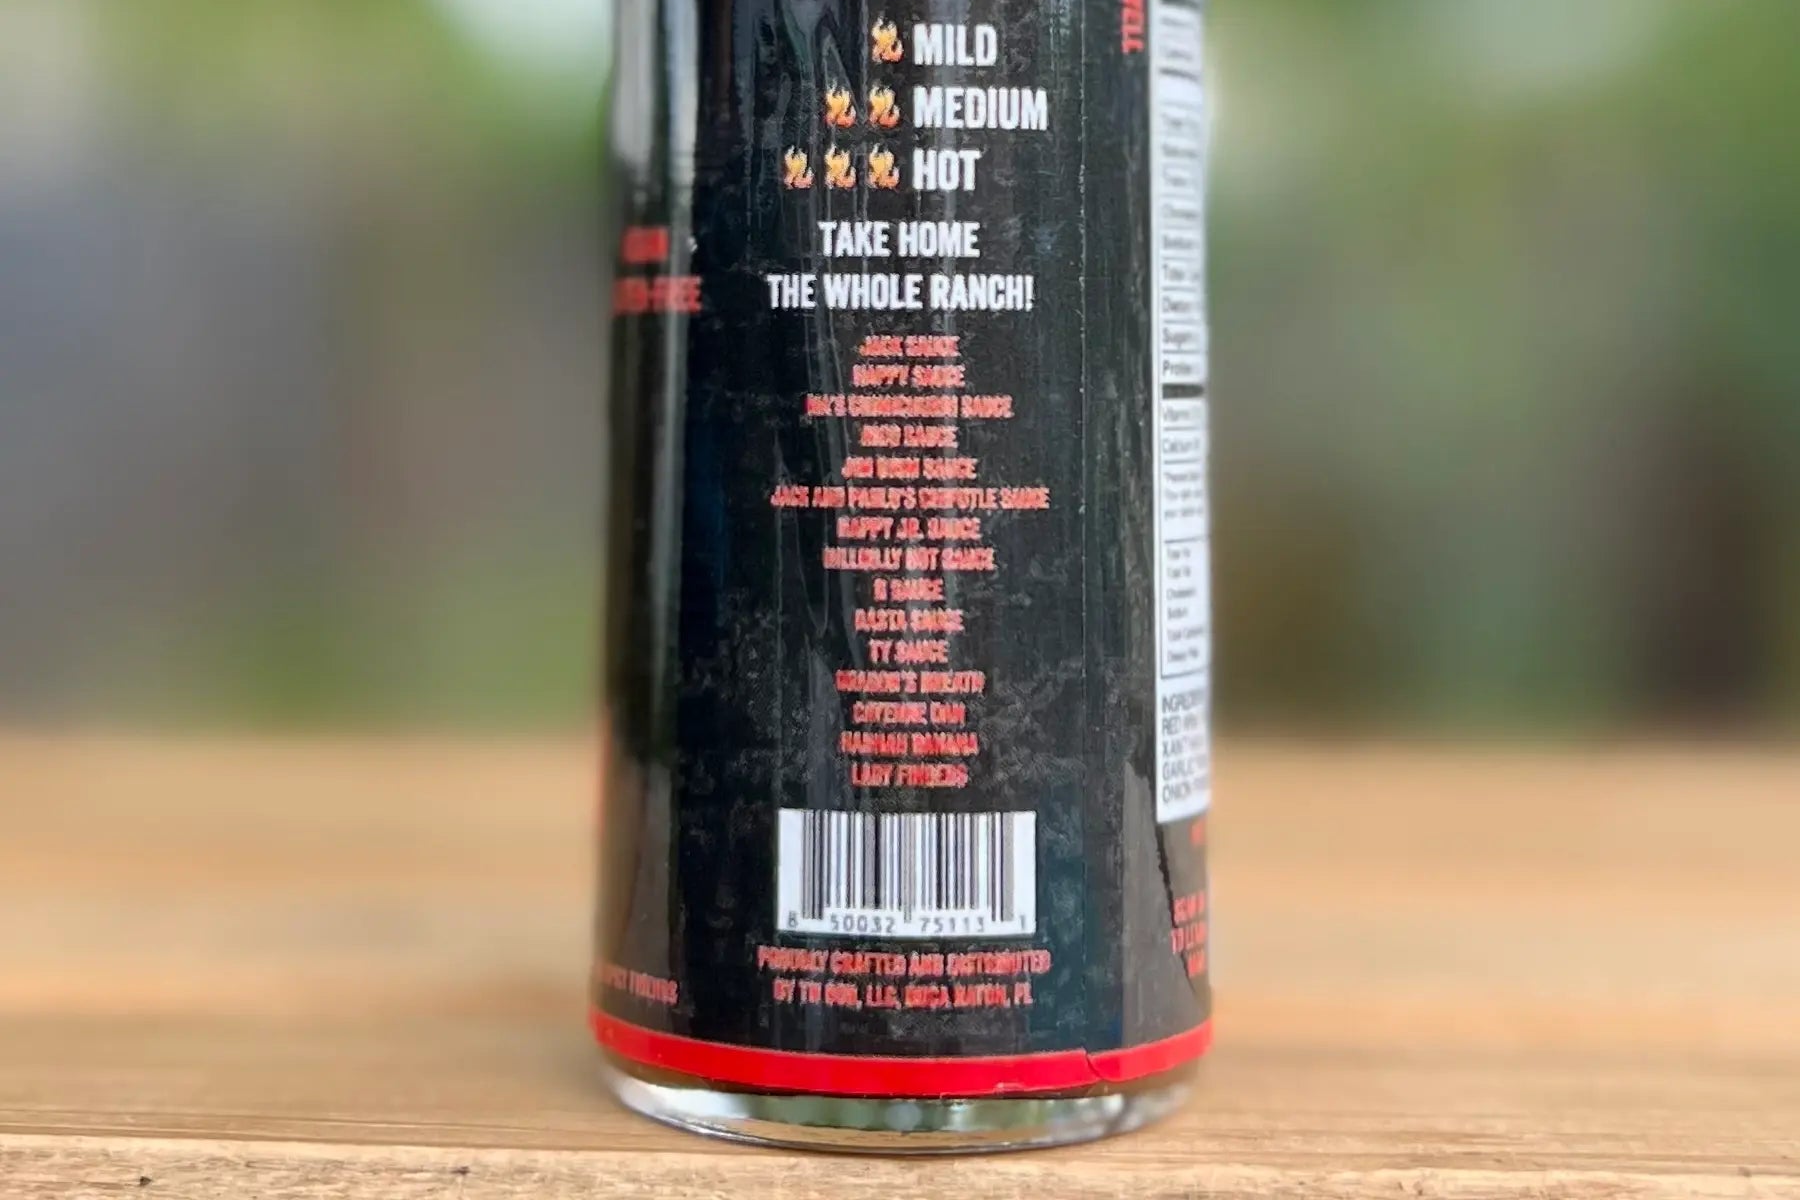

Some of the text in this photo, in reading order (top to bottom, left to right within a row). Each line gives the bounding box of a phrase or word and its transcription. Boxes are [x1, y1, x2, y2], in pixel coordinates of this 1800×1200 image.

[913, 23, 998, 67] MILD
[913, 85, 1048, 131] MEDIUM
[912, 147, 982, 193] HOT
[817, 220, 981, 258] TAKE HOME
[766, 273, 1034, 312] THE WHOLE RANCH!
[910, 365, 964, 389] SAUCE
[926, 517, 980, 541] SAUCE
[889, 577, 944, 602] SAUCE
[894, 640, 946, 665] SAUCE
[829, 912, 896, 934] 50032
[919, 917, 985, 934] 75113
